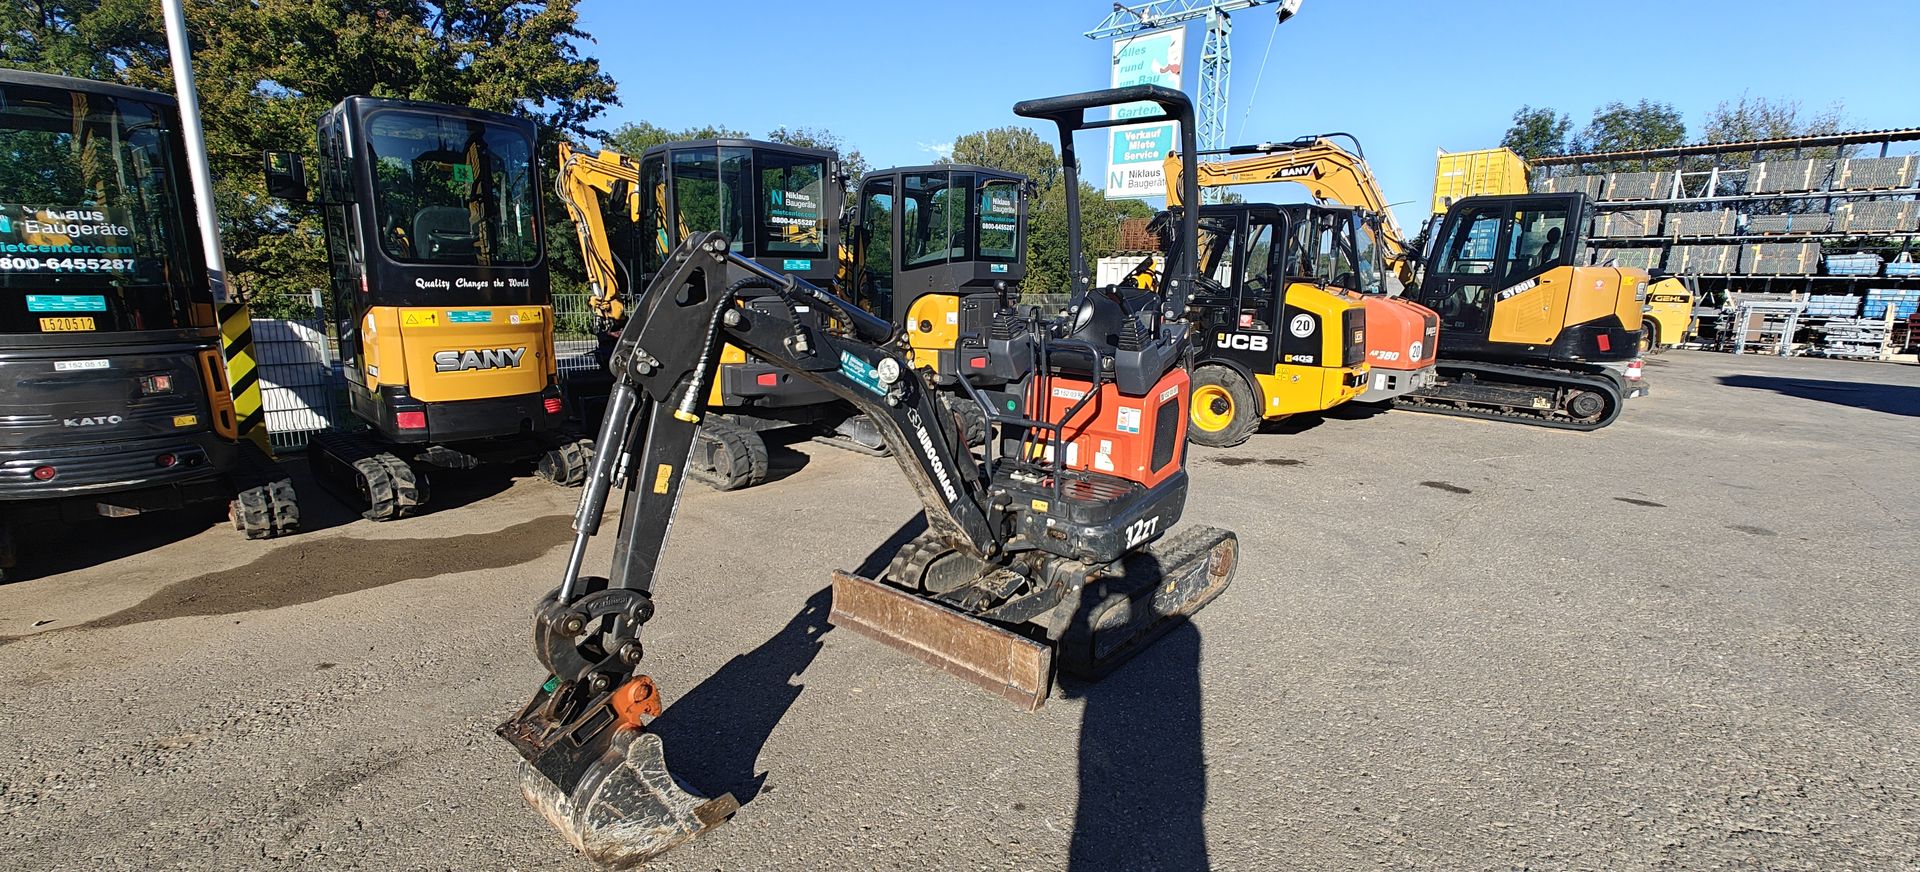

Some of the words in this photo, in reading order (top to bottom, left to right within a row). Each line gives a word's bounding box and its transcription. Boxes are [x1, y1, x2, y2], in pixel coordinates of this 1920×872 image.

[1121, 46, 1147, 58] Alles
[1120, 61, 1144, 73] rund
[1124, 128, 1162, 141] Verkauf
[1128, 140, 1156, 151] Miete
[1123, 150, 1160, 161] Service
[1128, 169, 1161, 179] Niklaus
[1280, 166, 1311, 177] SANY
[1127, 178, 1166, 189] Baugerät
[785, 191, 810, 201] Niklaus
[785, 199, 817, 209] Baugeräte
[771, 216, 817, 226] 0800-6455287
[24, 219, 129, 238] Baugeräte
[415, 277, 450, 291] Quality
[455, 277, 489, 291] Changes
[493, 278, 504, 287] the
[508, 278, 530, 288] World
[1502, 279, 1536, 300] SY80U
[1654, 295, 1685, 303] GEHL
[1295, 320, 1310, 331] 20
[1216, 333, 1269, 352] JCB
[1412, 345, 1421, 358] 20
[434, 347, 526, 373] SANY
[1292, 354, 1314, 364] 403
[64, 415, 123, 427] KATO
[916, 426, 958, 504] EUROCOMACH
